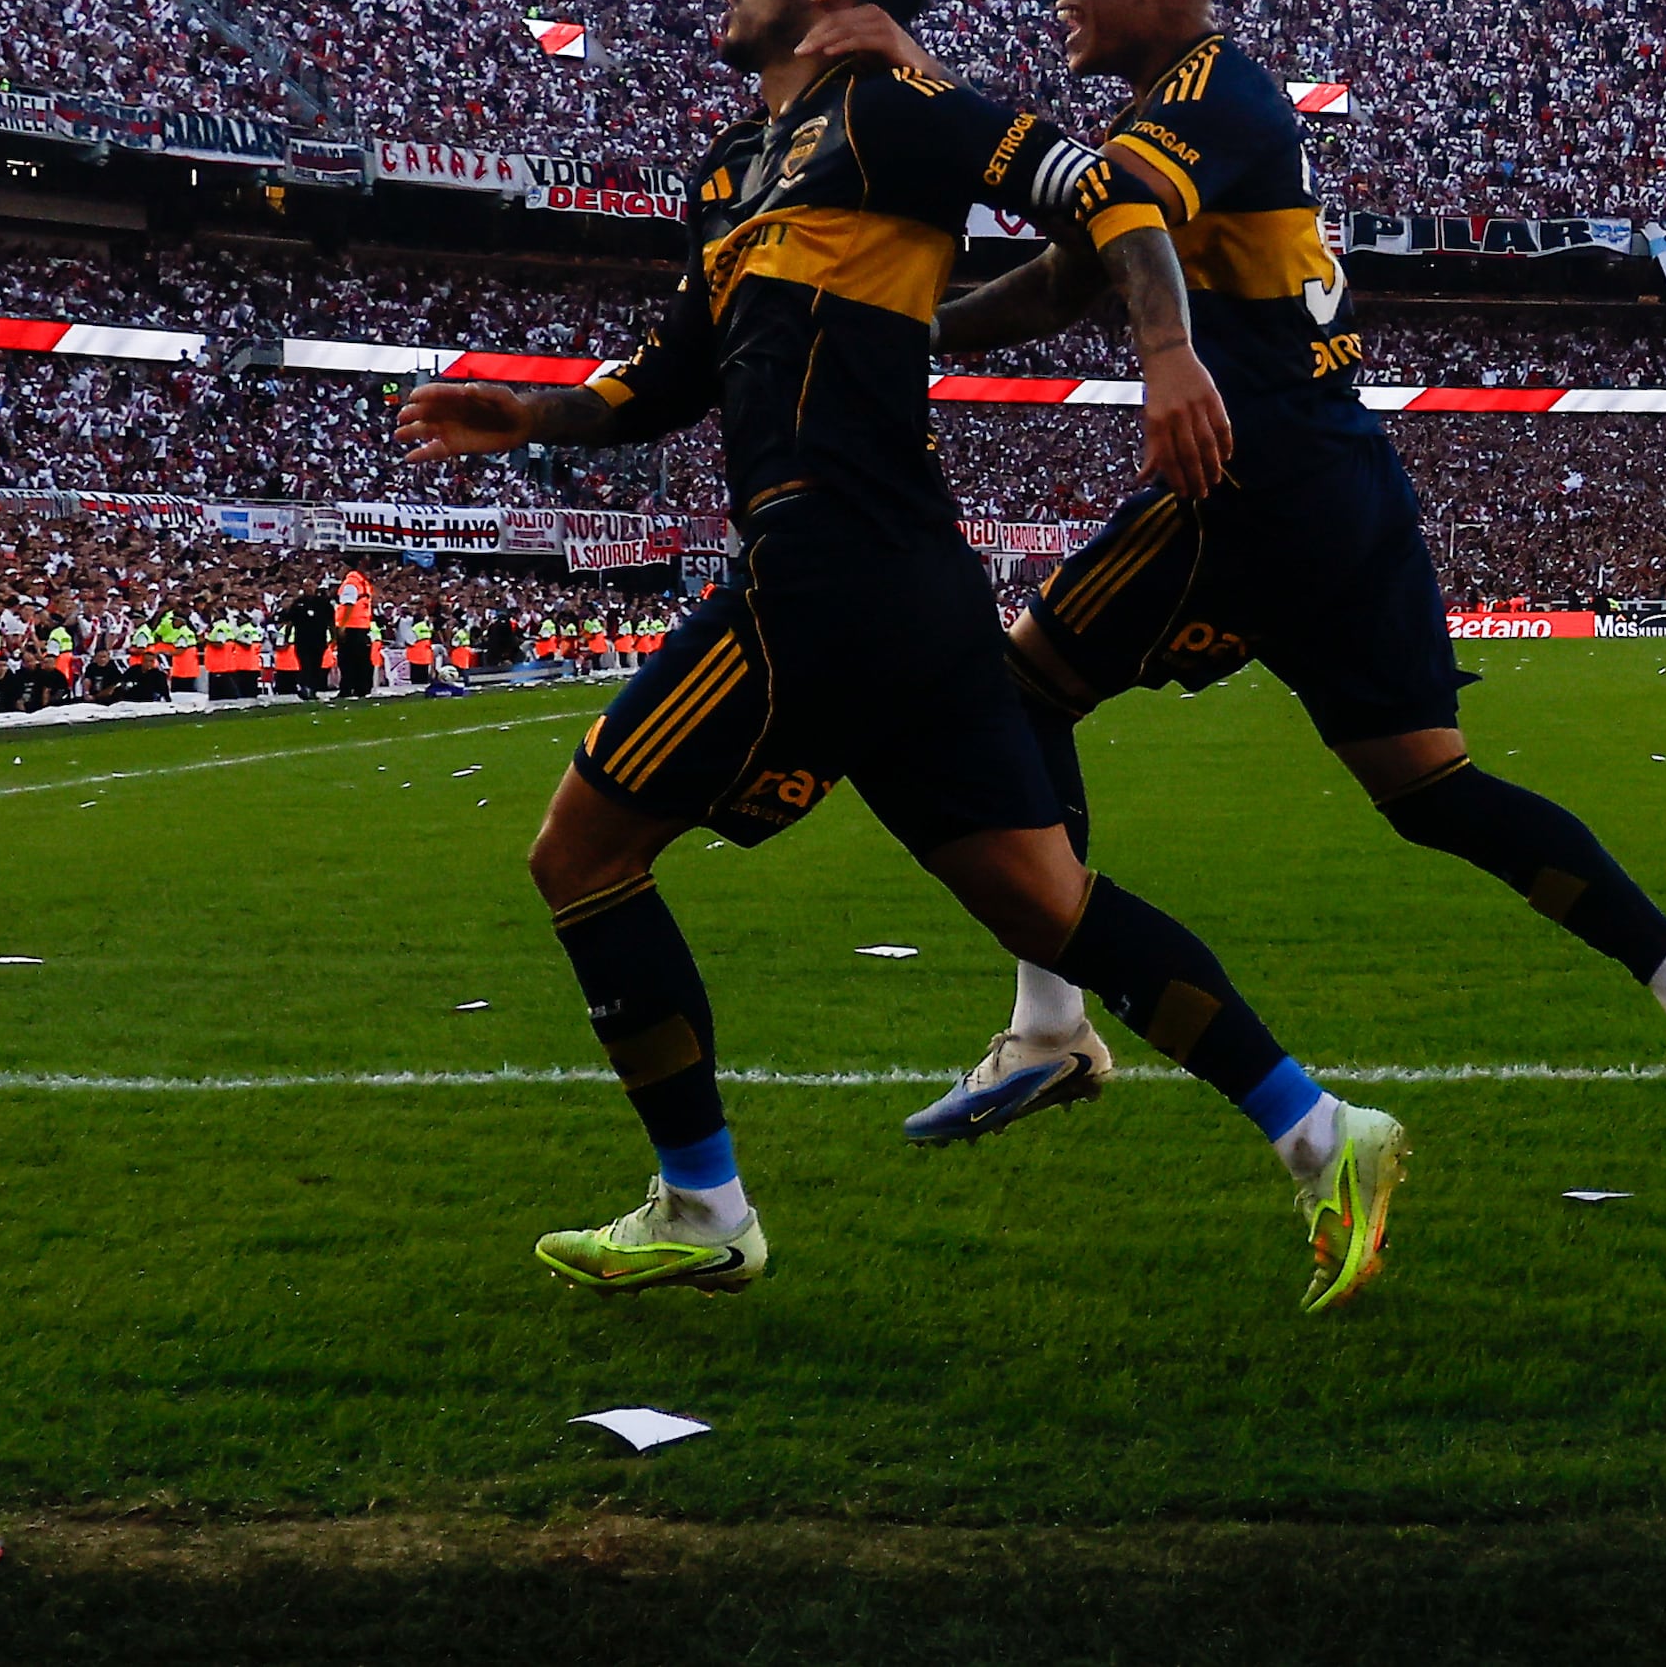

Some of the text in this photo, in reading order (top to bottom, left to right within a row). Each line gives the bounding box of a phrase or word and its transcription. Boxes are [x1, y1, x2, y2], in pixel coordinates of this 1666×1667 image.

[381, 143, 514, 181] CARAZA
[1350, 210, 1595, 258] PILAR
[346, 511, 405, 546] VILLA
[411, 518, 438, 549] DE
[444, 519, 501, 549] MAYO
